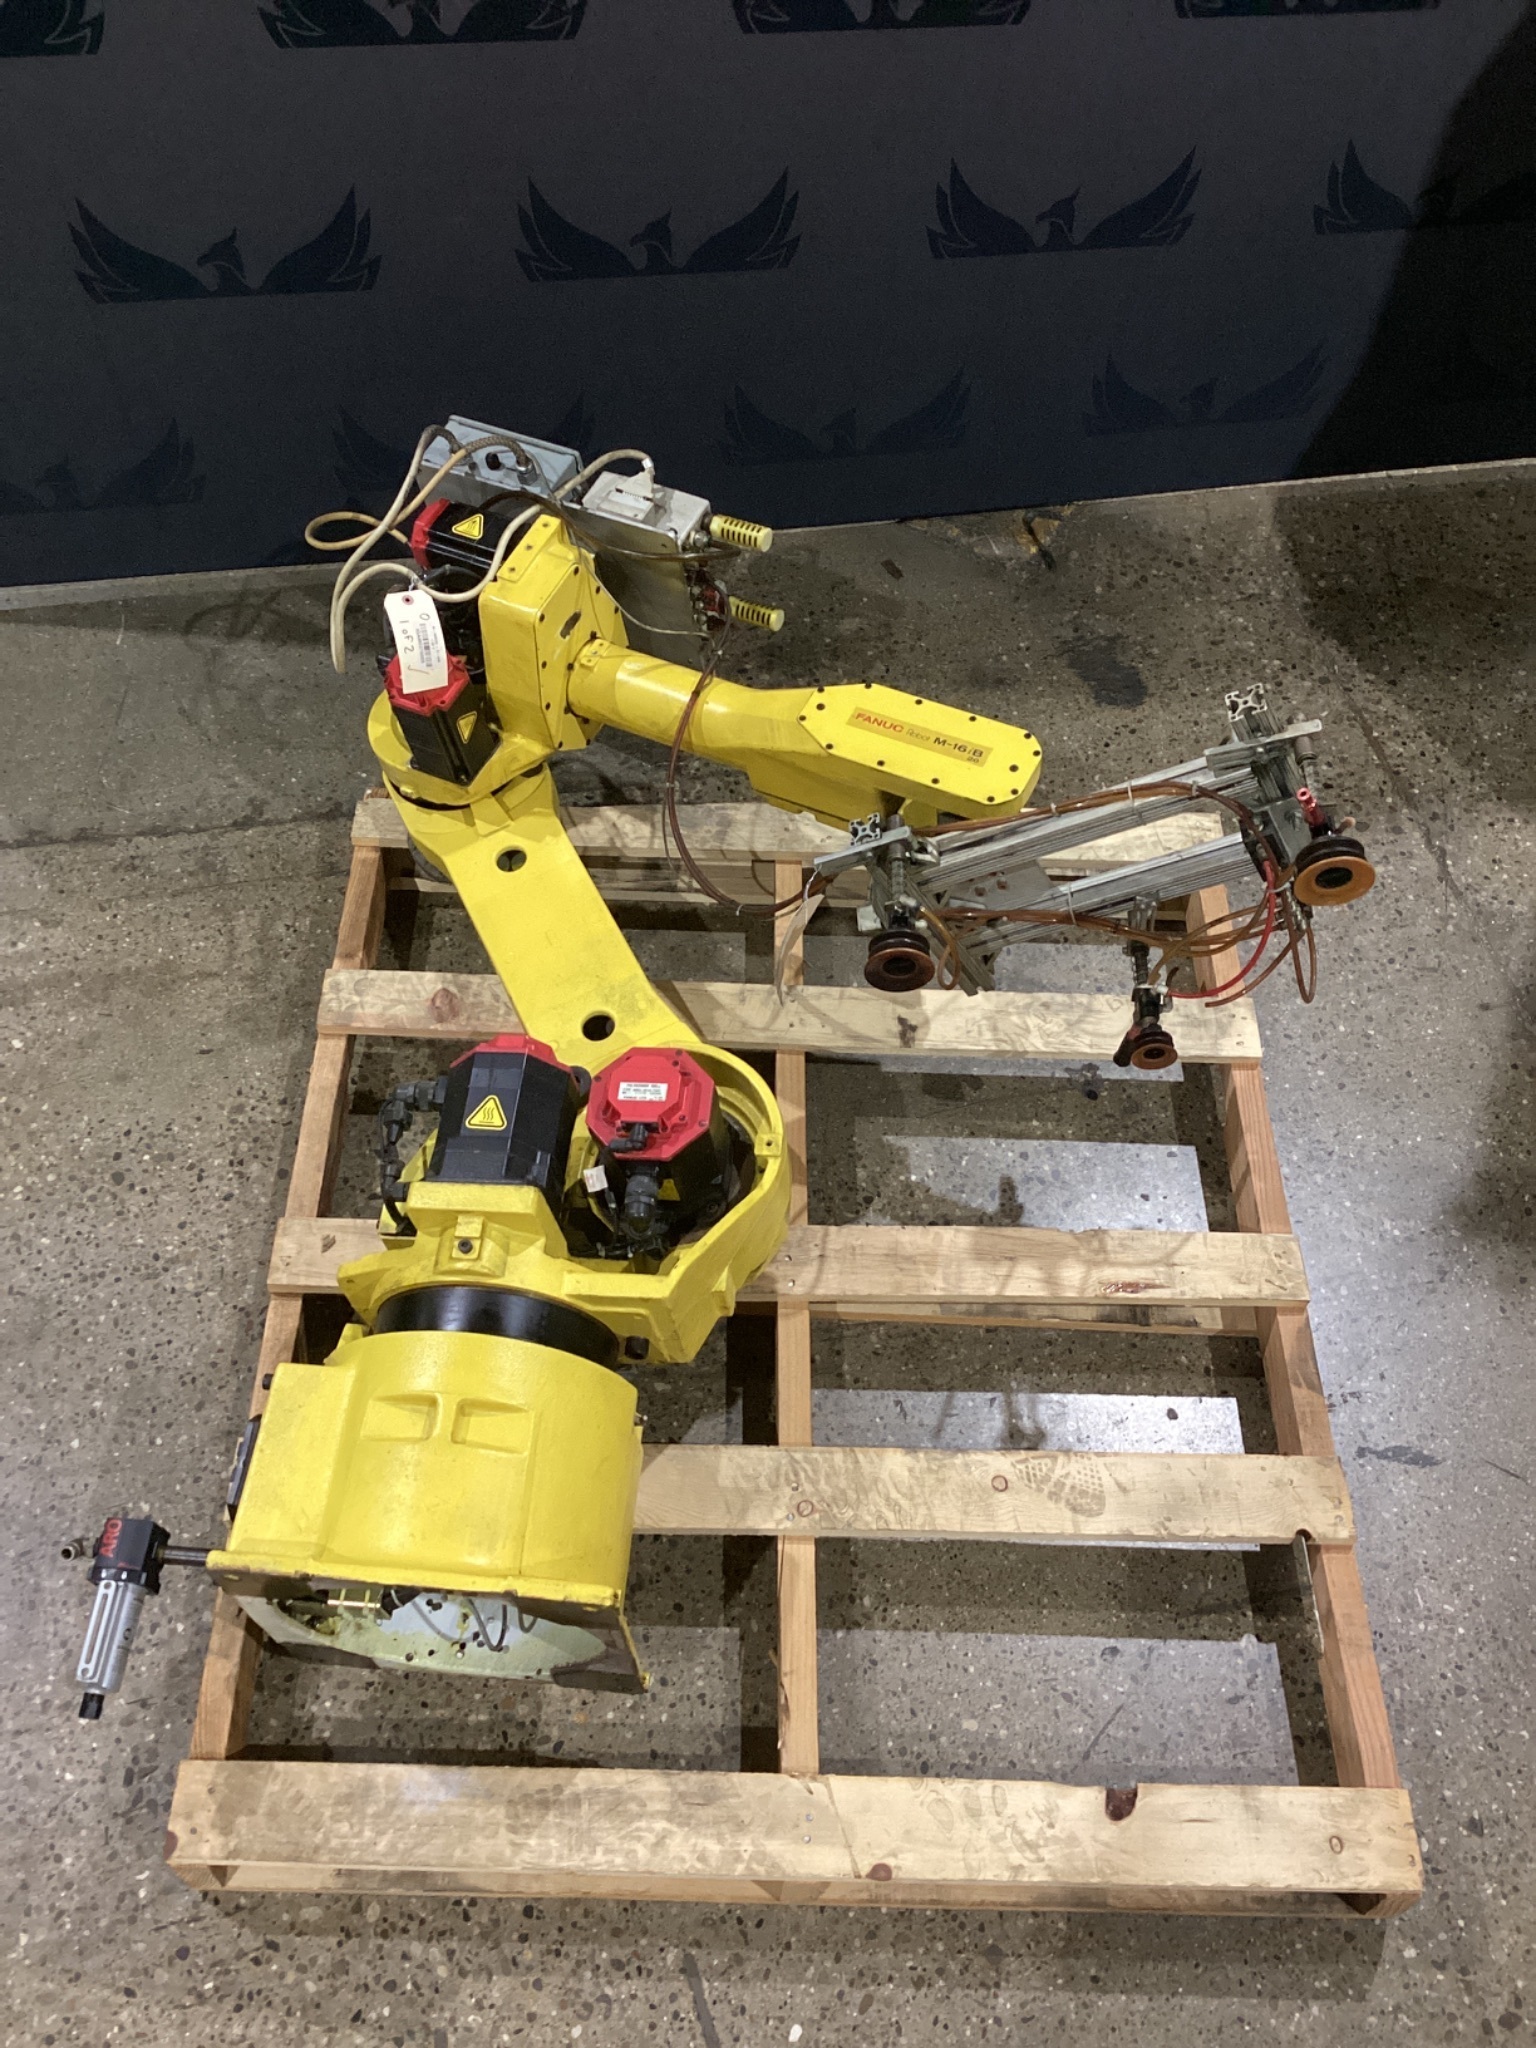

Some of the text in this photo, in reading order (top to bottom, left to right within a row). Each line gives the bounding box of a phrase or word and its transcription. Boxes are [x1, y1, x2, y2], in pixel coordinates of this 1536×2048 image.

[403, 645, 415, 654] 2
[855, 712, 905, 733] FANUC
[98, 1518, 122, 1558] ARO
